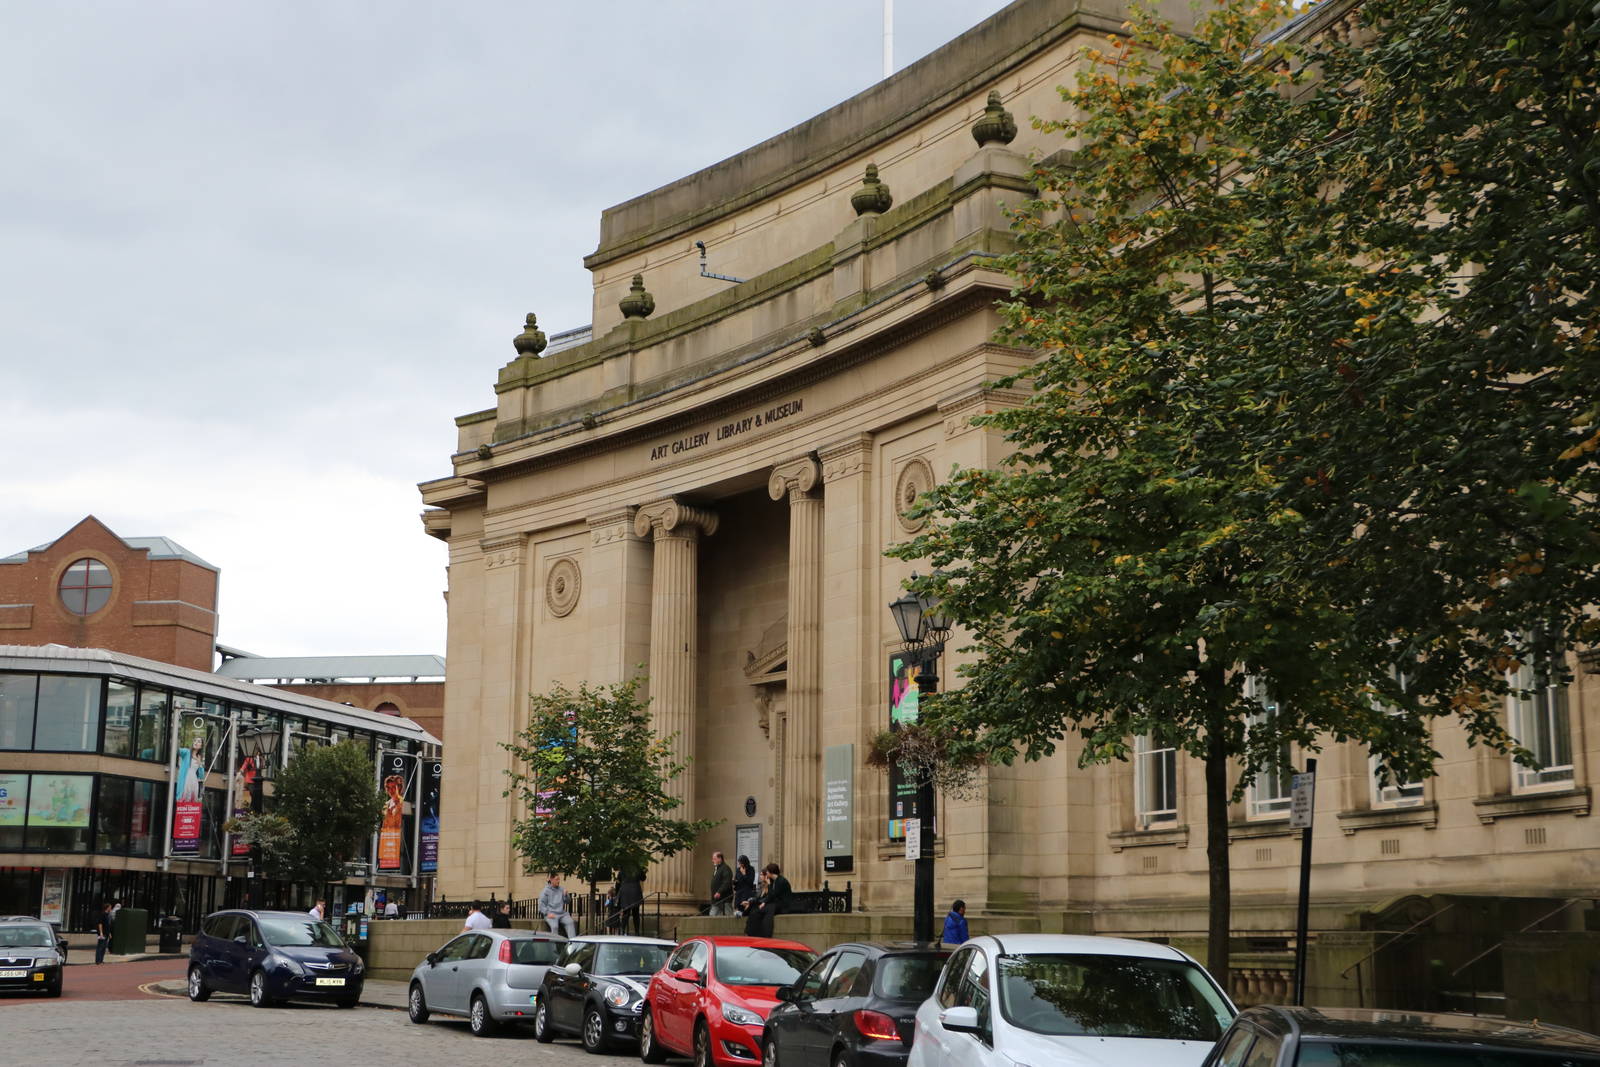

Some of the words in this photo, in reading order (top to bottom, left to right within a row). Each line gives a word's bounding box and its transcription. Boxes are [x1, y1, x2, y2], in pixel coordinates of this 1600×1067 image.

[651, 445, 669, 461] ART
[672, 432, 710, 454] GALLERY
[717, 417, 753, 441] LIBRARY
[755, 414, 762, 427] &
[765, 399, 803, 425] MUSEUM
